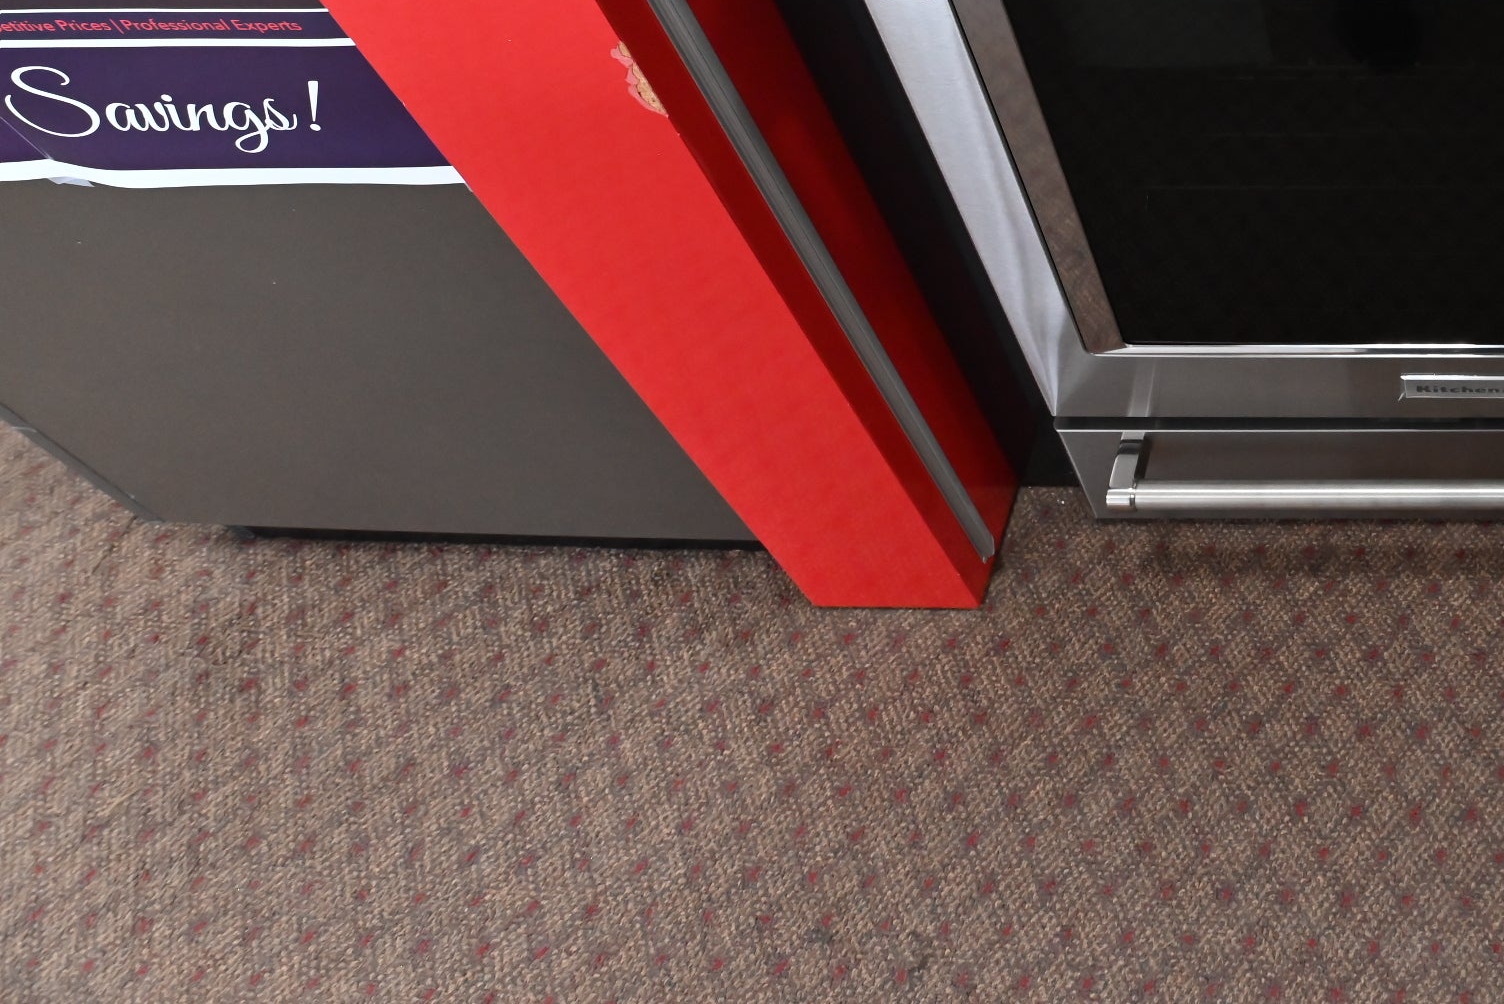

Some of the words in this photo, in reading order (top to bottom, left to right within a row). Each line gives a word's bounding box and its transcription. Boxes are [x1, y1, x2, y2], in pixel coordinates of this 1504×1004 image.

[54, 19, 112, 31] Prices
[119, 18, 231, 31] Professional
[230, 19, 303, 33] Experts
[5, 66, 322, 153] Savings!
